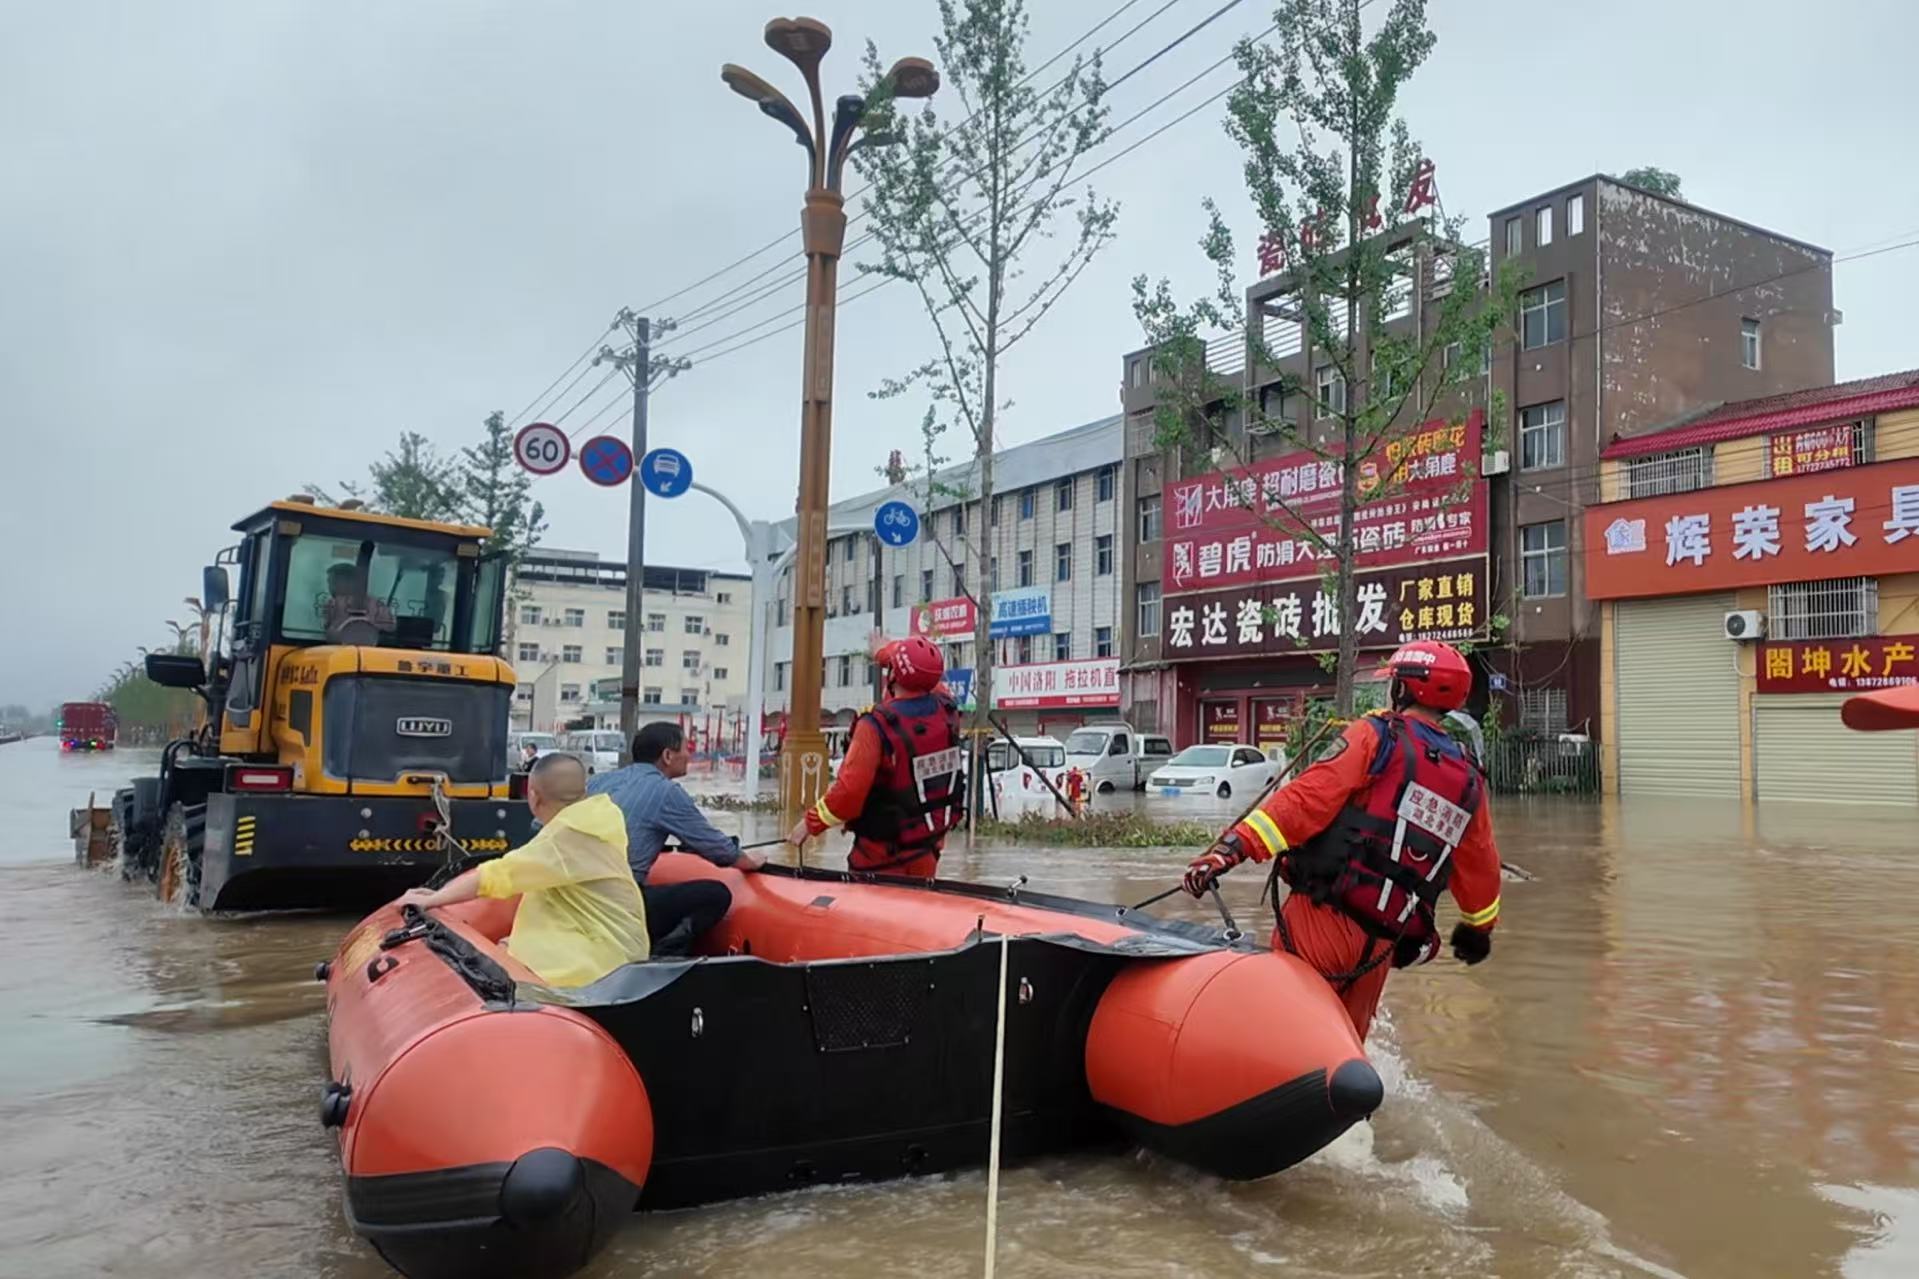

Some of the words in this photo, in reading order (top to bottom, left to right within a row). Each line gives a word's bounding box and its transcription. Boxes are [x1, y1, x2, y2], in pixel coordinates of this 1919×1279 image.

[526, 437, 559, 463] 60
[1261, 459, 1345, 501] 超耐磨瓷
[1399, 572, 1474, 602] 厂家直销
[1170, 583, 1389, 648] 宏达瓷砖批发
[1399, 601, 1475, 631] 仓库现货
[1409, 789, 1464, 829] 应急消防
